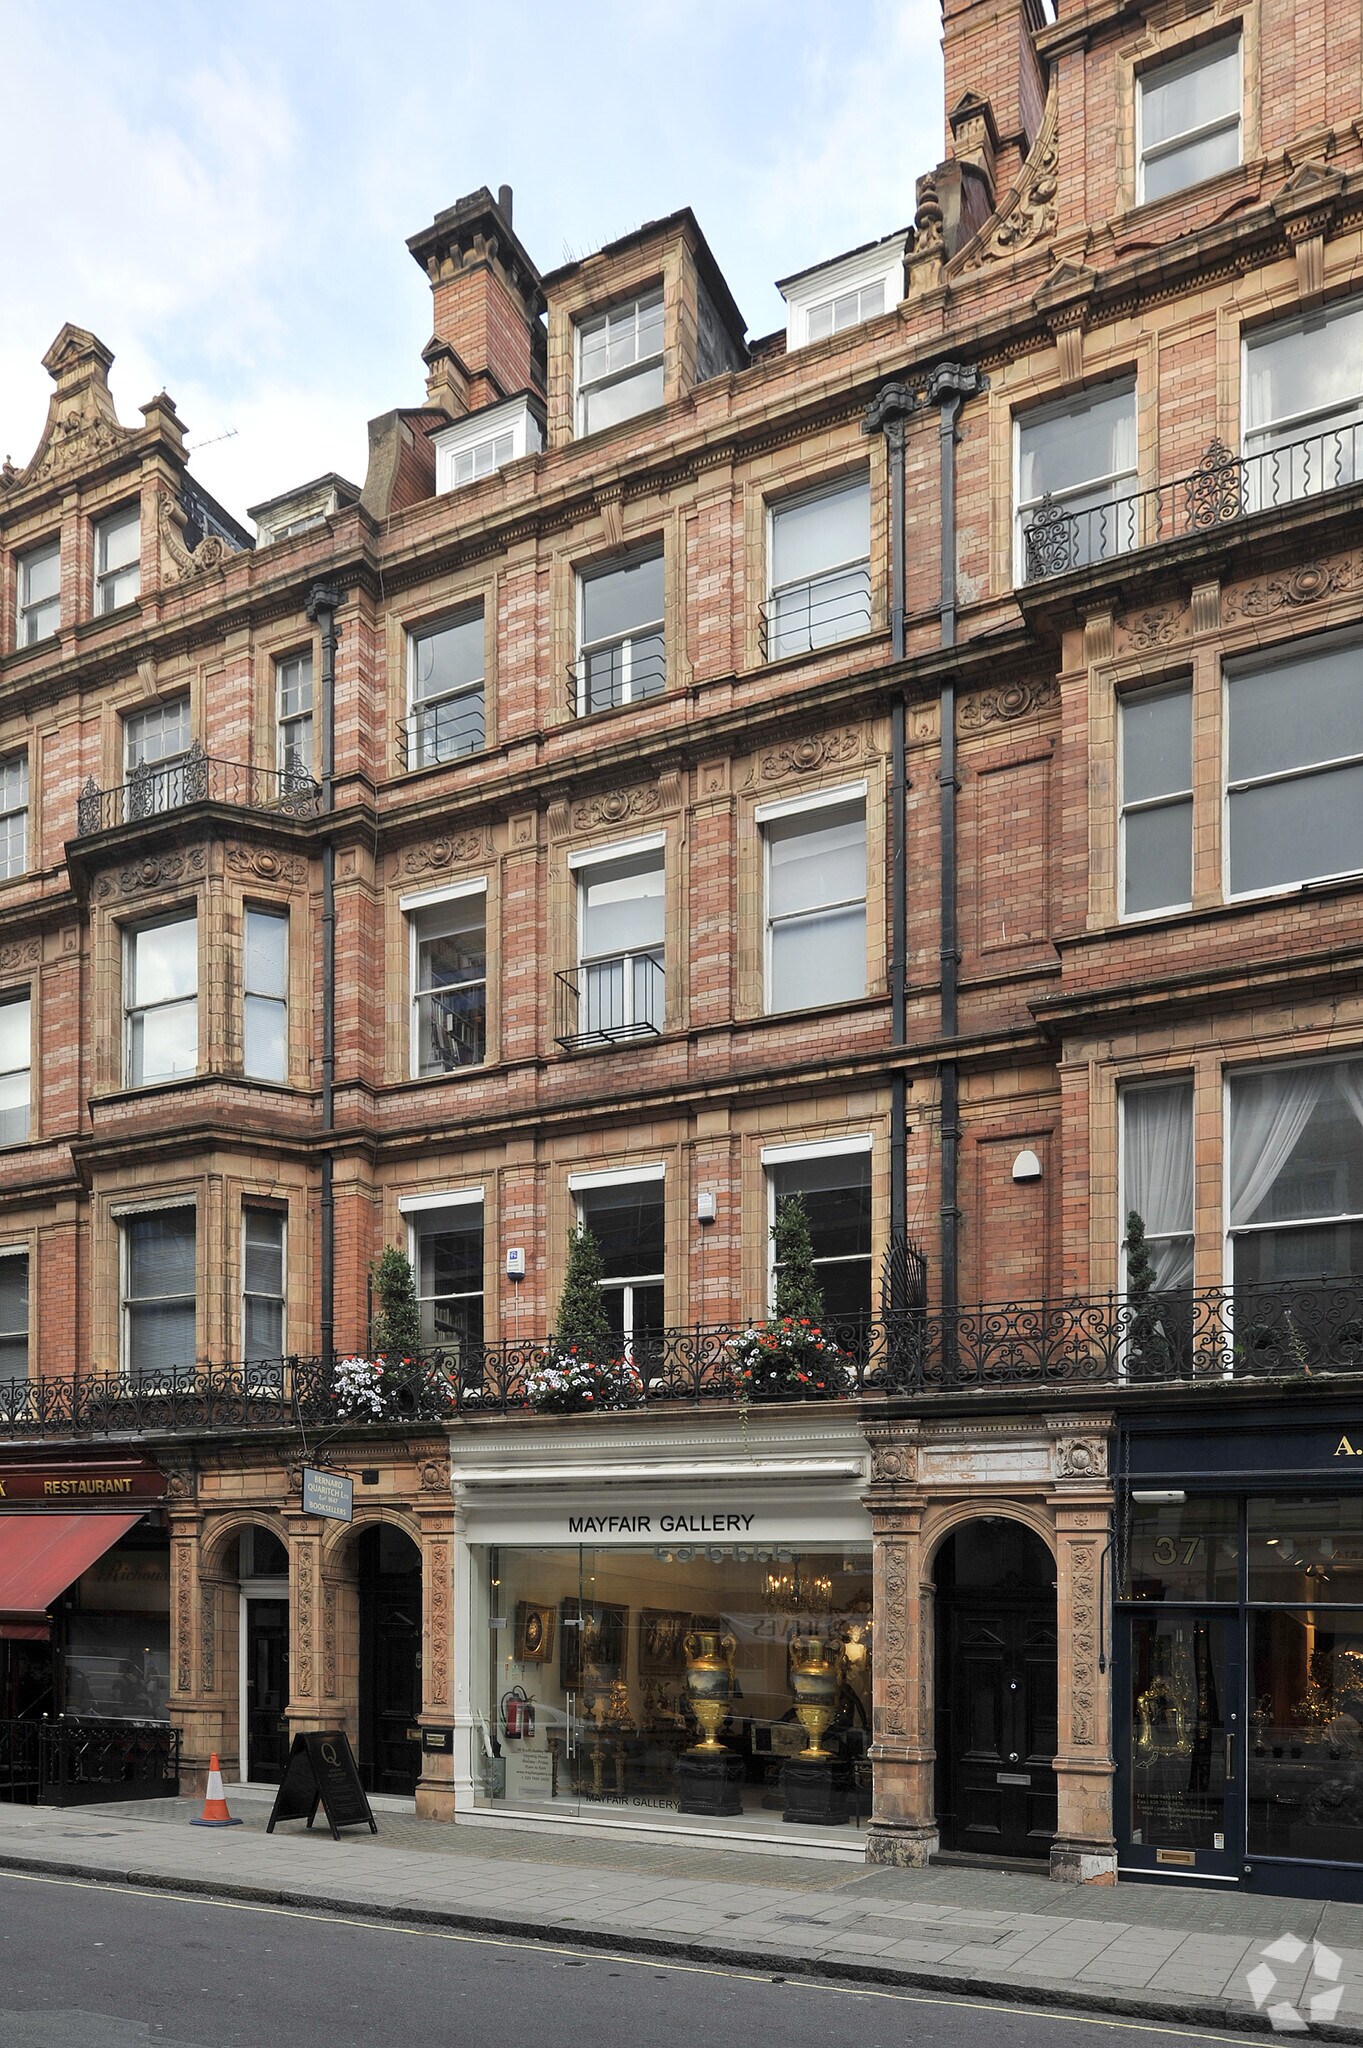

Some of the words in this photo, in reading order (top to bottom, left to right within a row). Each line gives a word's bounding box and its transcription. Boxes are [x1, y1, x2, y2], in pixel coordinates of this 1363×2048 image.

[1333, 1435, 1363, 1456] A.
[43, 1478, 132, 1495] RESTAURANT
[307, 1483, 340, 1497] QUARITCH
[314, 1475, 343, 1489] BERNARD
[308, 1501, 347, 1516] BOOKSELLERS
[568, 1516, 652, 1533] MAYFAIR
[659, 1514, 755, 1532] GALLERY
[1152, 1535, 1202, 1566] 37
[321, 1742, 342, 1767] Q
[586, 1793, 629, 1806] MAYFAIR
[632, 1797, 680, 1810] GALLERY
